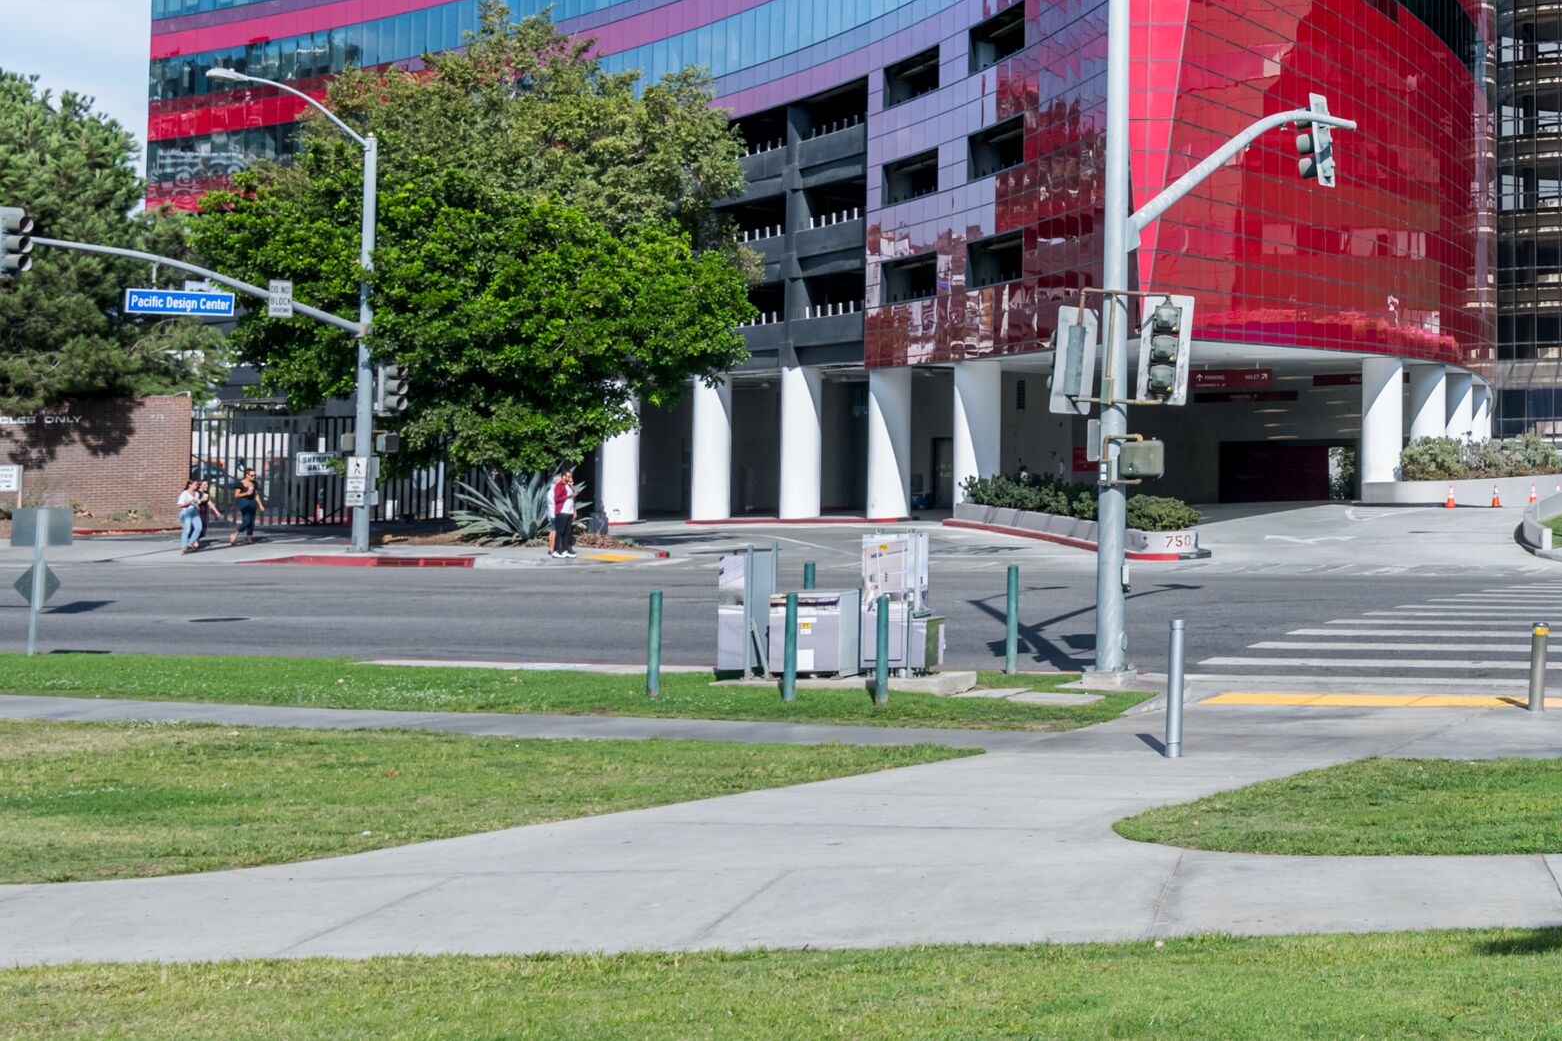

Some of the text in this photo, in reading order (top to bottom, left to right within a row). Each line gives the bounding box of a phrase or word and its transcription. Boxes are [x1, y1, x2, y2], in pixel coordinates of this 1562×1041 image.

[131, 294, 231, 312] Pacific Design Center
[44, 415, 82, 424] ONLY
[1165, 535, 1192, 548] 750
